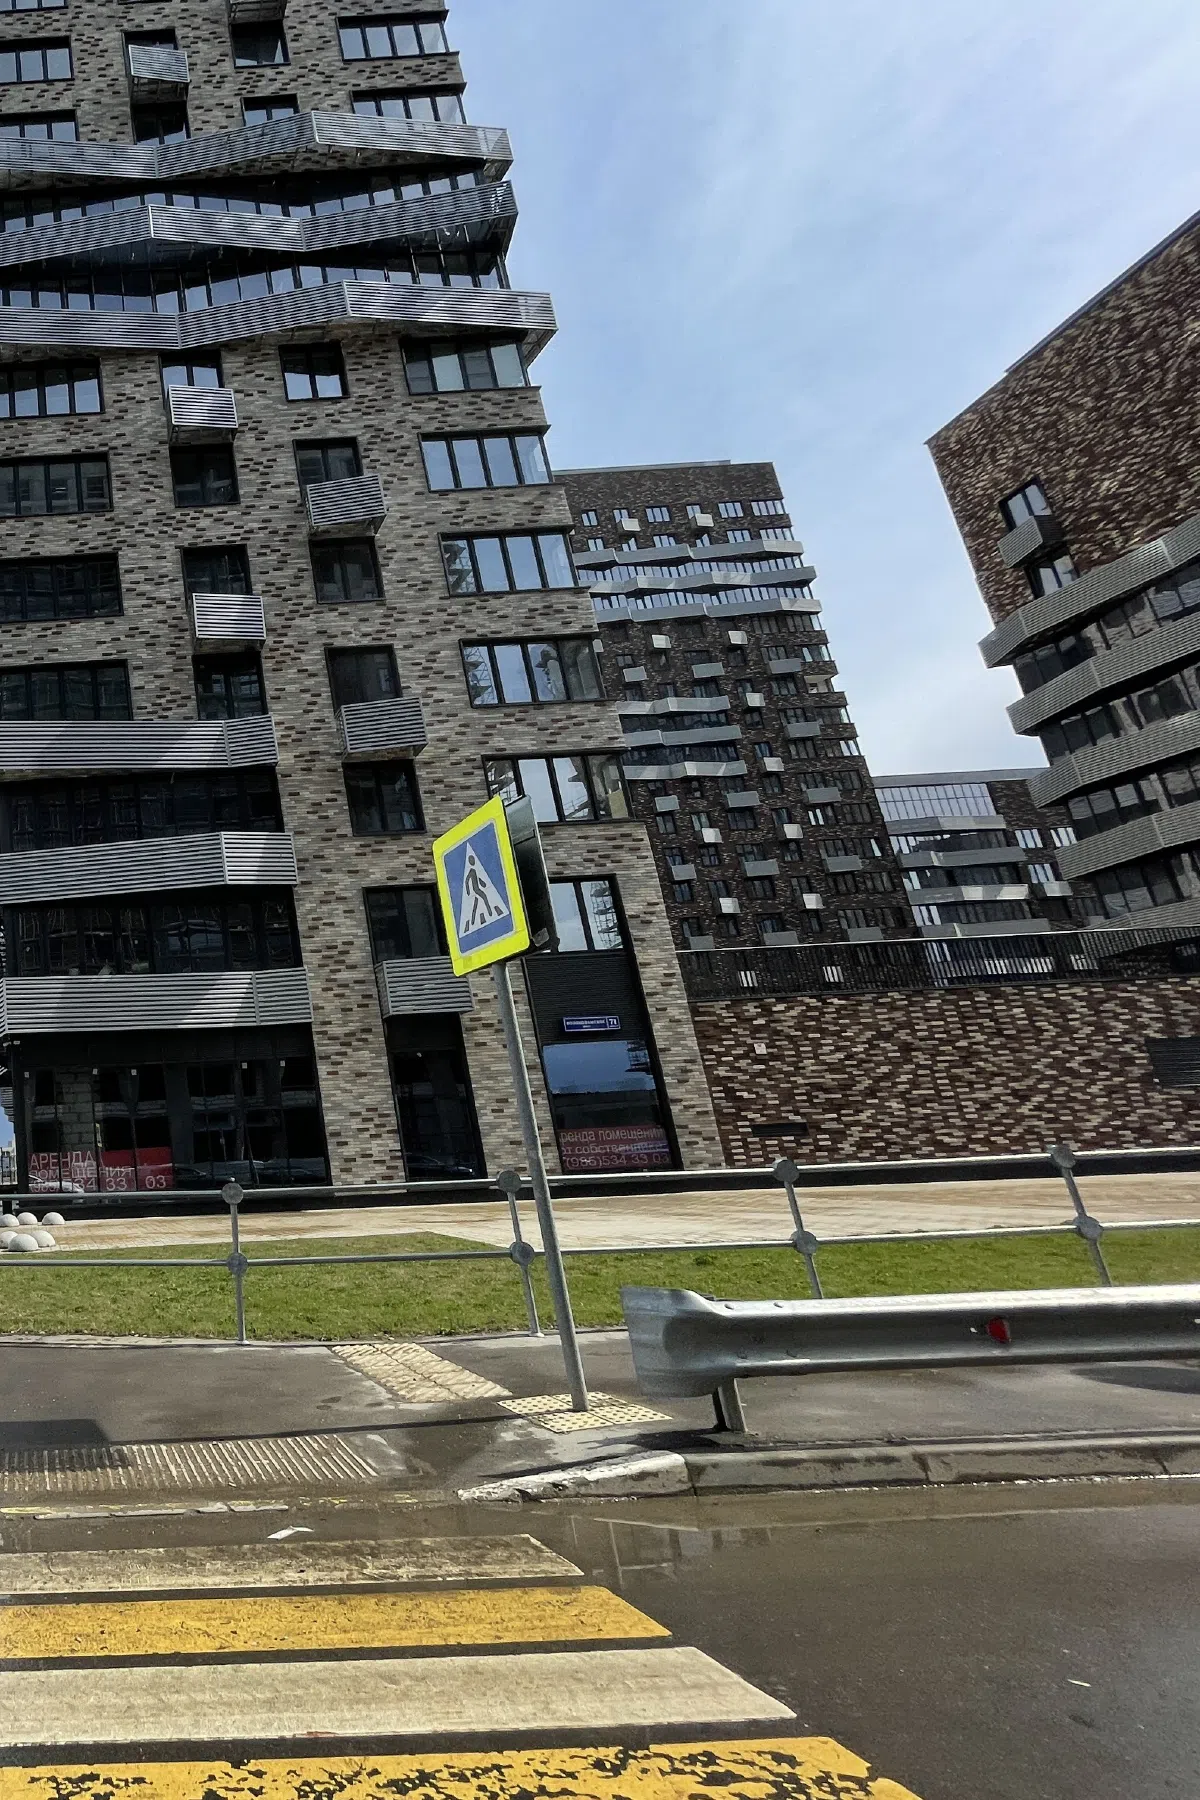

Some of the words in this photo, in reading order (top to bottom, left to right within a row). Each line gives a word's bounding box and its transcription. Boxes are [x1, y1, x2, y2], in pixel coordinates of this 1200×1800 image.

[559, 1131, 596, 1143] ренда
[29, 1151, 96, 1169] АРЕНДА
[563, 1155, 628, 1169] (985)534
[632, 1153, 648, 1164] 33
[29, 1166, 132, 1179] ПОМЕЩЕНИЯ
[106, 1177, 128, 1191] 33
[146, 1175, 168, 1189] 03
